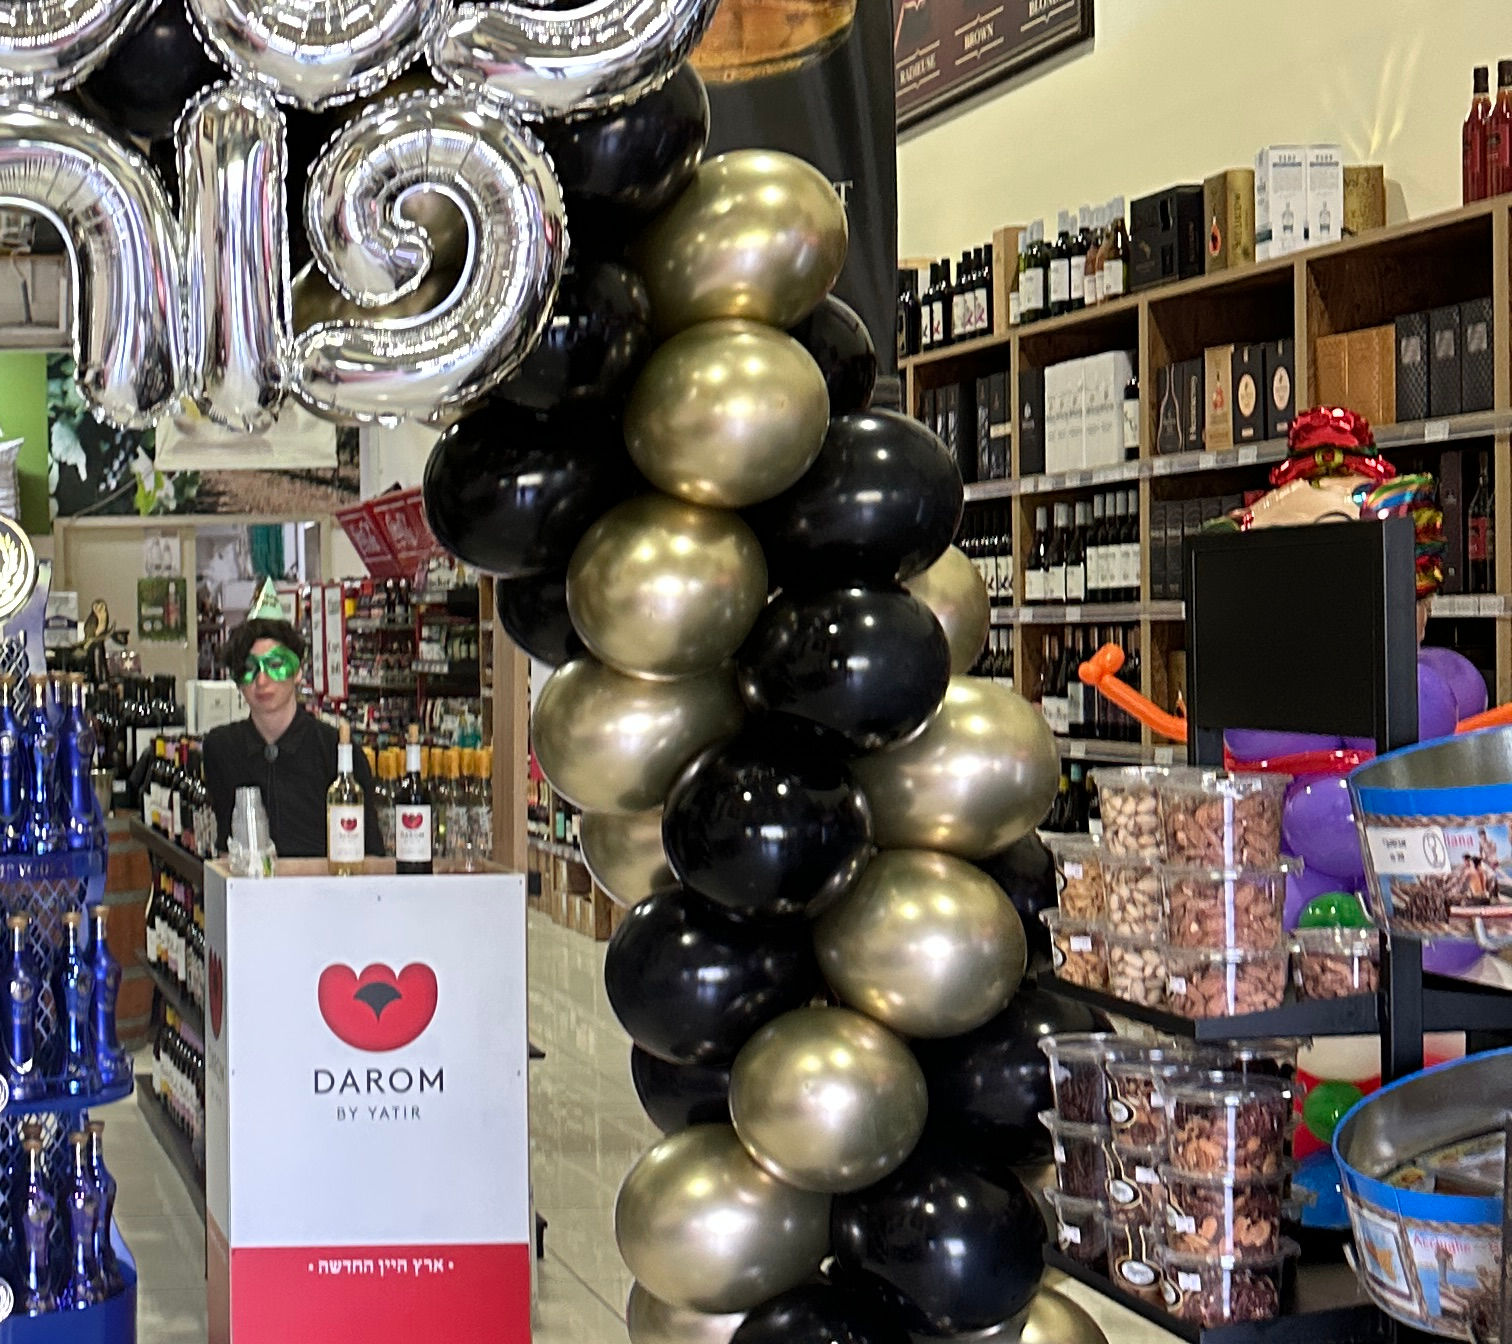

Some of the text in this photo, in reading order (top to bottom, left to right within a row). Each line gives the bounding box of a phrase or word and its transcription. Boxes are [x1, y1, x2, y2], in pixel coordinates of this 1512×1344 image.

[963, 22, 995, 51] BROWN
[313, 1066, 444, 1095] DAROM
[336, 1104, 421, 1122] BY YATIR
[412, 1258, 444, 1278] ארץ
